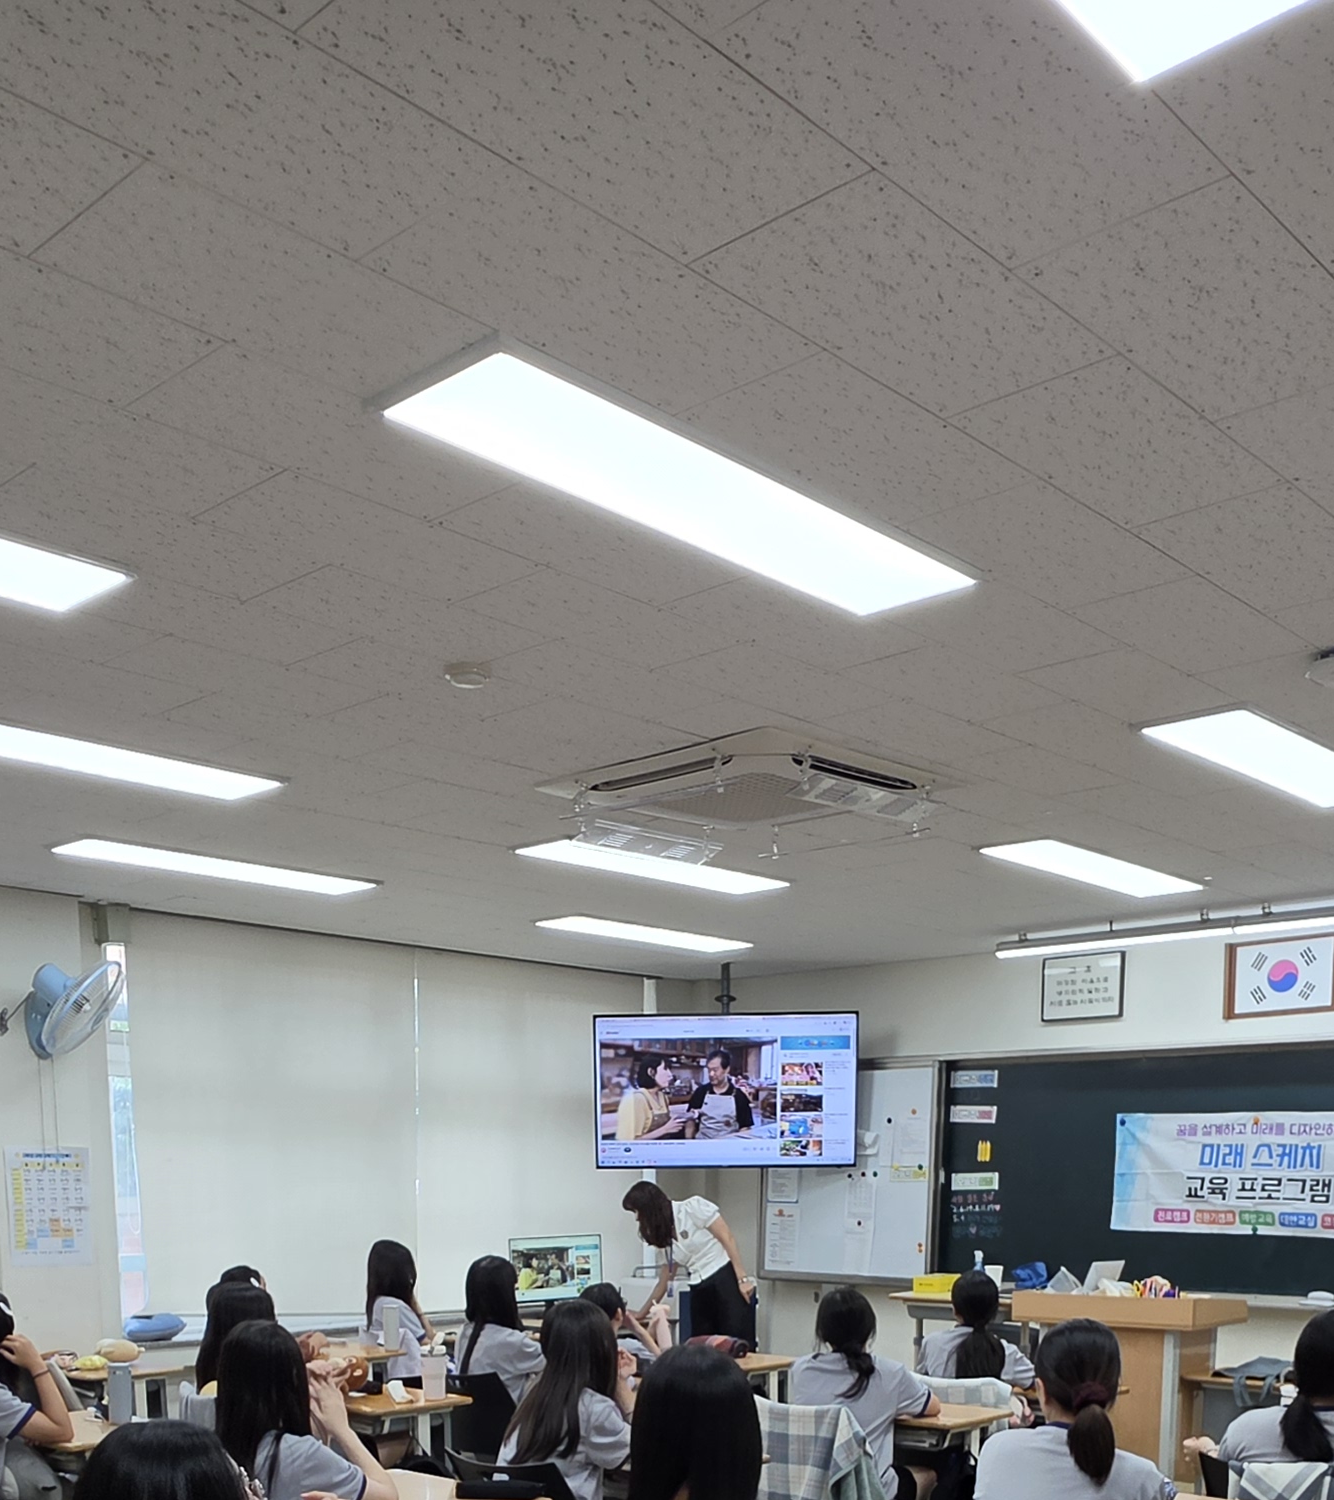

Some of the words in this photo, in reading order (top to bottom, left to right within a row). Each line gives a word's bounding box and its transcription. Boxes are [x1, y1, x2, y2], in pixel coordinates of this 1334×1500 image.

[1176, 1123, 1198, 1136] 꿈을
[1201, 1122, 1247, 1136] 설계하고
[1251, 1122, 1286, 1136] 미래를
[1198, 1142, 1246, 1169] 미래
[1250, 1143, 1323, 1170] 스케치
[1185, 1175, 1230, 1201] 교육
[1235, 1177, 1333, 1203] 프로그램
[1279, 1213, 1316, 1228] 대안교실
